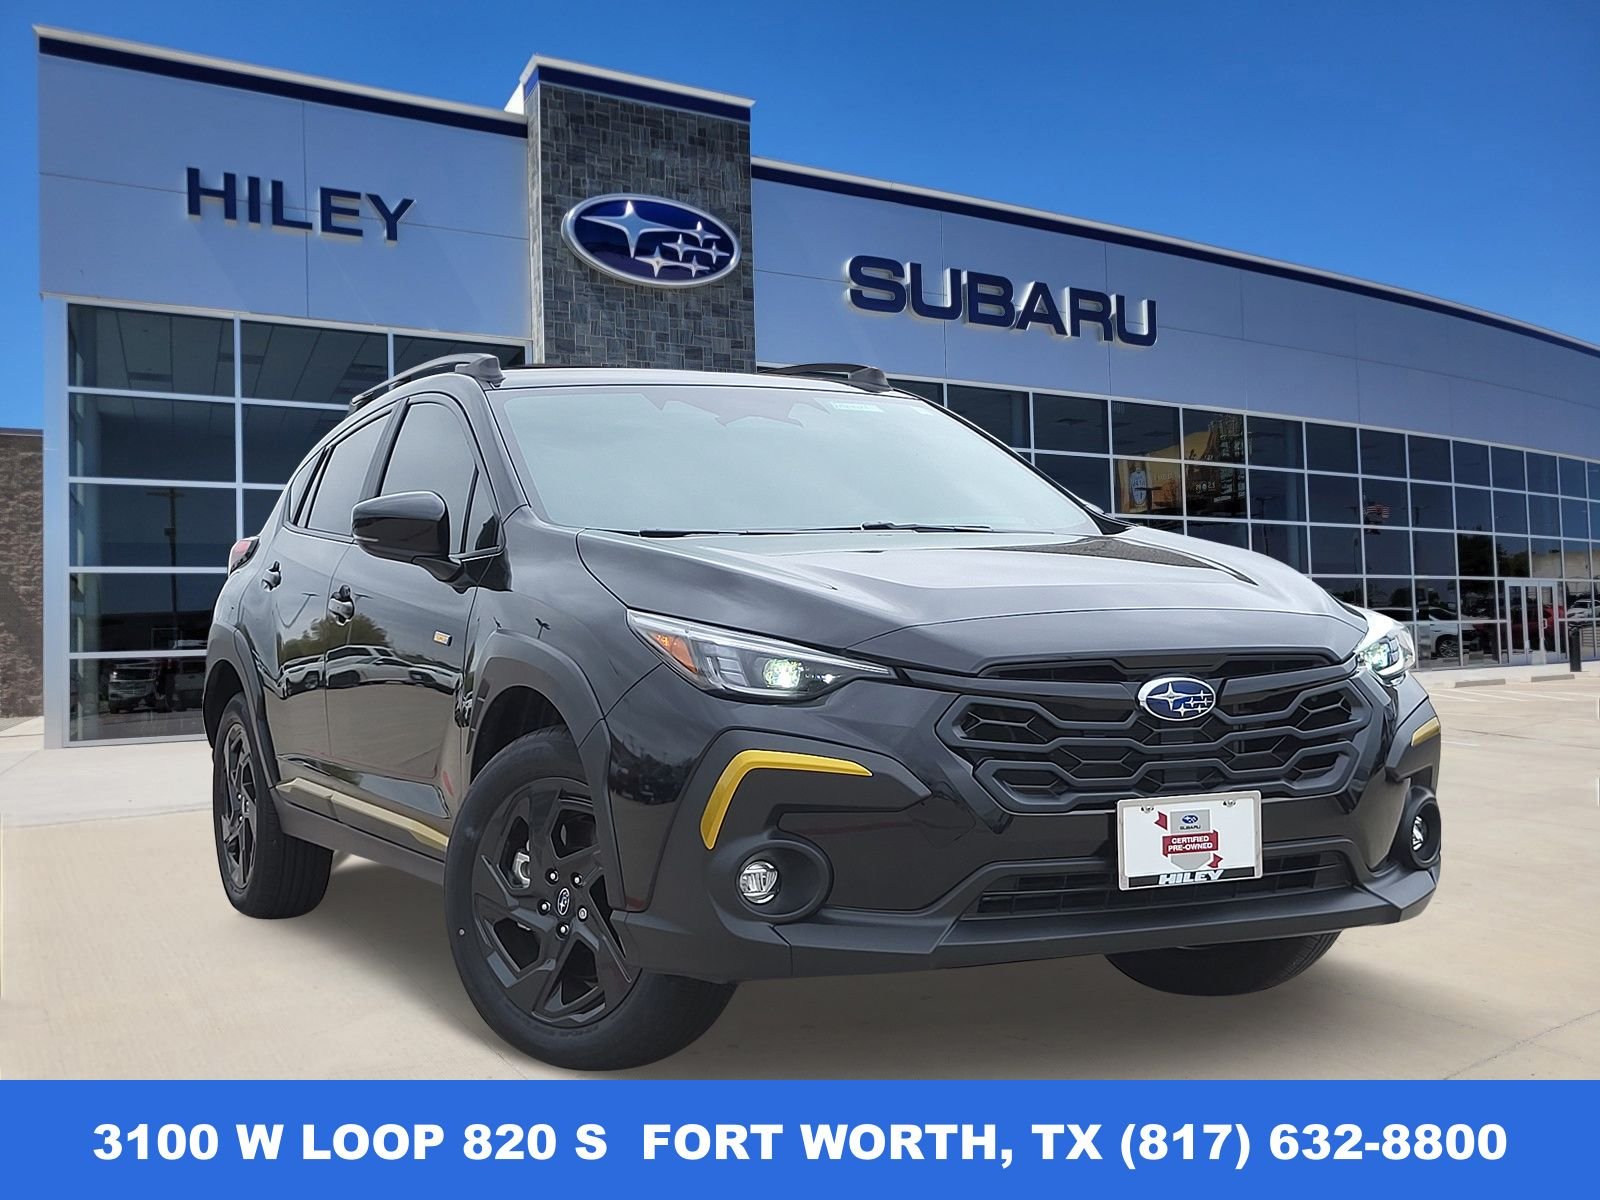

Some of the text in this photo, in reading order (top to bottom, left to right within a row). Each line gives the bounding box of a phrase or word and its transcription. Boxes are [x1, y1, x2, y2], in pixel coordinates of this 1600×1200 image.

[186, 166, 416, 243] HILEY
[847, 254, 1158, 347] SUBARU
[1168, 843, 1213, 852] PRE-OWNED
[1171, 836, 1210, 844] CERTIFIED
[1159, 870, 1224, 885] HILEY
